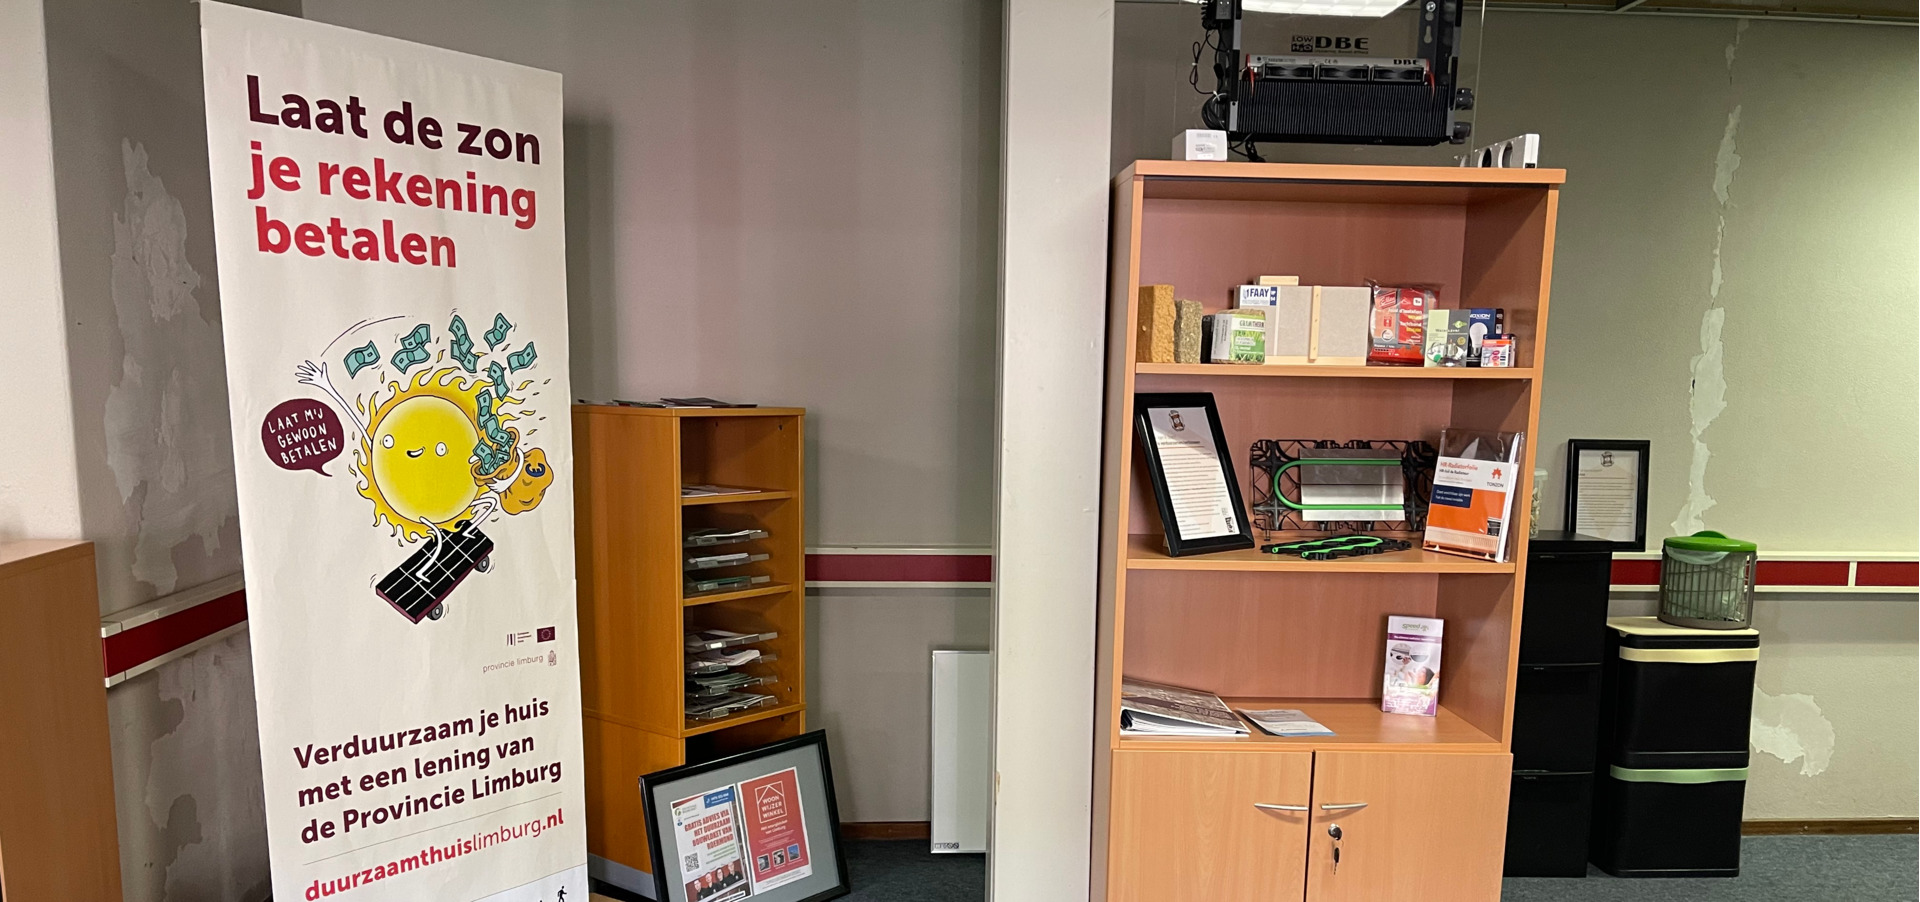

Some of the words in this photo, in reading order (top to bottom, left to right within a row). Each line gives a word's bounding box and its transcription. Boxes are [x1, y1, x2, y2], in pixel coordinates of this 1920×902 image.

[1315, 36, 1369, 50] DBE
[247, 75, 368, 139] Laat
[383, 101, 443, 150] de
[457, 122, 540, 165] zon
[247, 141, 301, 200] je
[318, 158, 537, 230] rekening
[255, 206, 456, 268] betalen
[1250, 288, 1270, 298] FAAY
[268, 412, 299, 434] LAAT
[277, 422, 327, 448] GEWOON
[280, 437, 337, 464] BETALEN
[482, 659, 515, 674] provincie
[516, 654, 544, 666] limburg
[293, 717, 474, 769] Verduurzaam
[478, 709, 499, 736] je
[505, 697, 550, 725] huis
[298, 775, 353, 808] met
[359, 766, 408, 792] een
[414, 746, 490, 779] lening
[495, 736, 535, 759] van
[301, 818, 336, 845] de
[342, 786, 466, 833] Provincie
[472, 761, 562, 800] Limburg
[760, 802, 783, 812] WIJZER
[762, 795, 780, 805] WOON
[762, 809, 784, 819] WINKEL
[304, 808, 565, 902] duurzaamthuislimburg.nl
